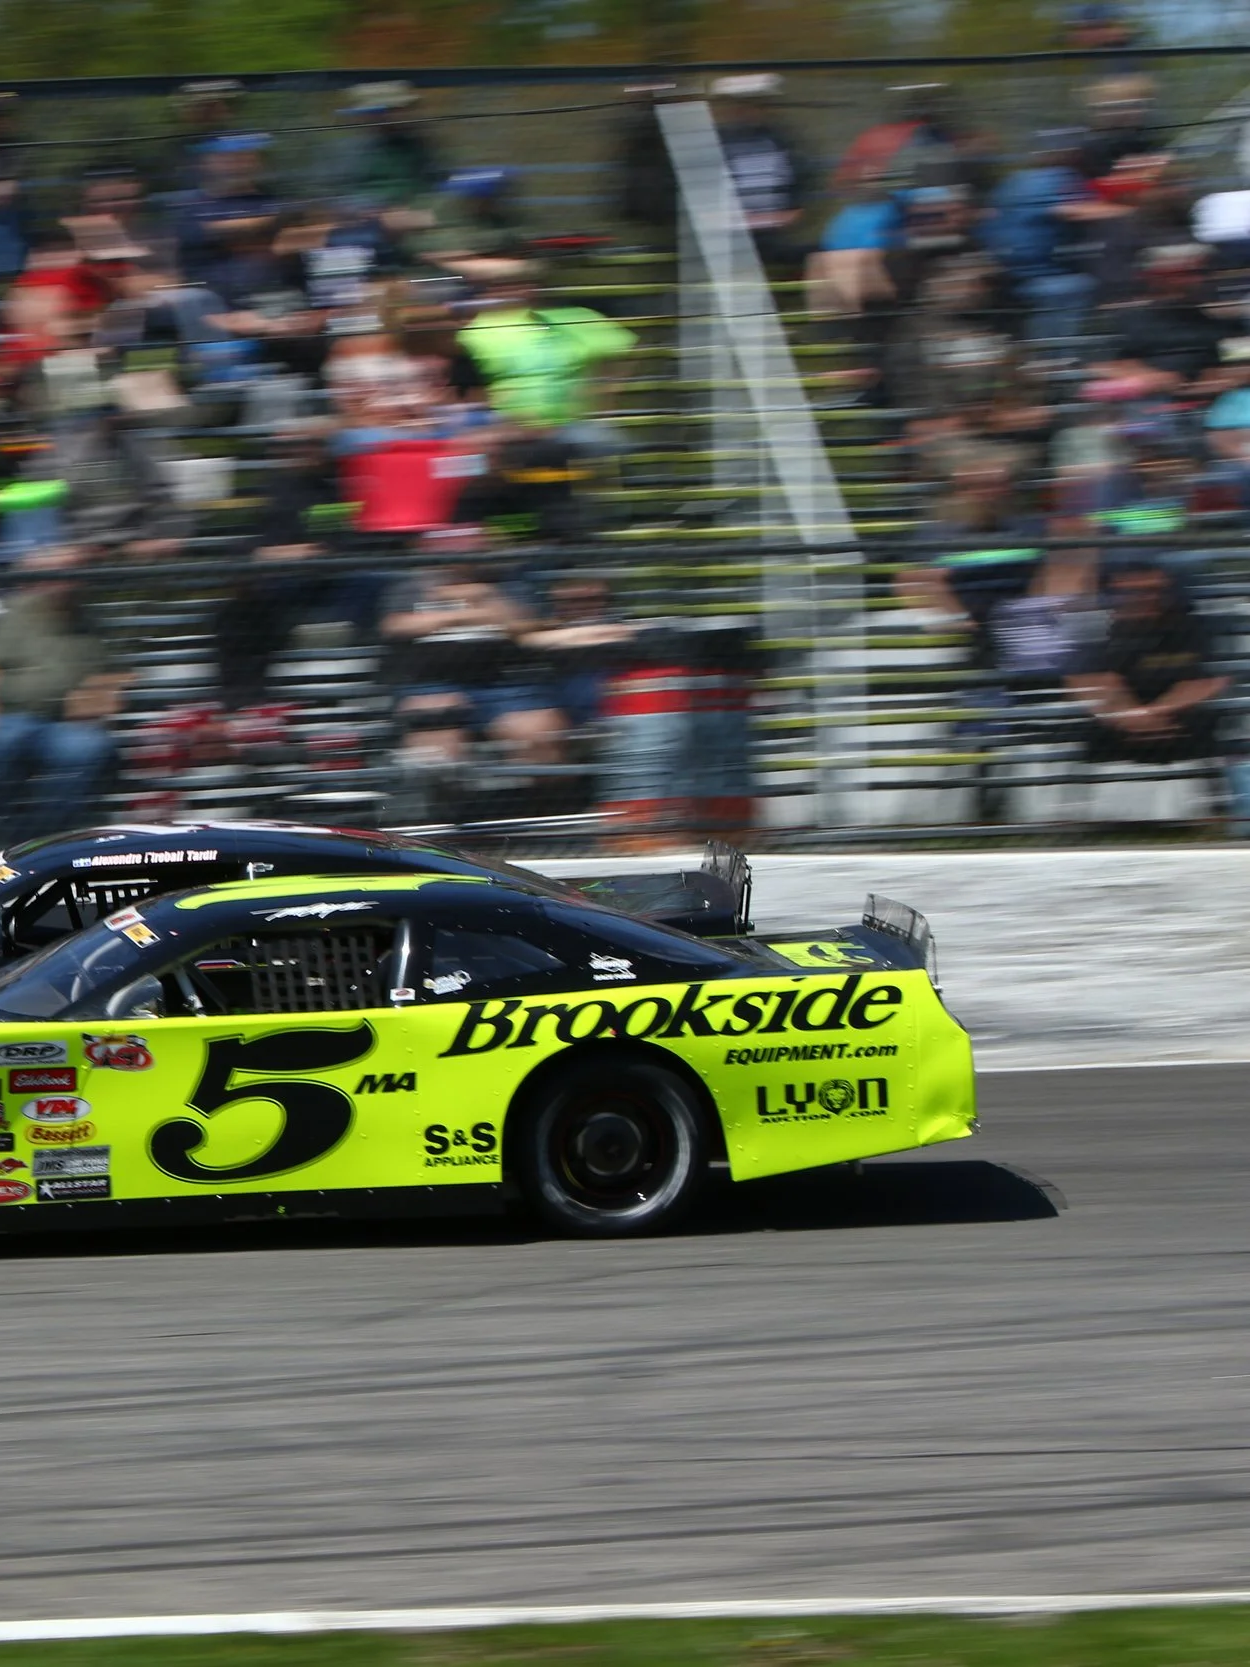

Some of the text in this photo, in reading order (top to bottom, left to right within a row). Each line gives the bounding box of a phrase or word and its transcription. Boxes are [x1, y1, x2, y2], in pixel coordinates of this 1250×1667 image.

[437, 975, 902, 1058] Brookside
[4, 1046, 55, 1057] DRP
[724, 1043, 898, 1065] EQUIPMENT.com
[354, 1072, 417, 1094] MA
[145, 1018, 379, 1185] 5
[761, 1113, 832, 1123] AUCTION
[424, 1122, 496, 1155] S&S
[425, 1154, 500, 1167] APPLIANCE
